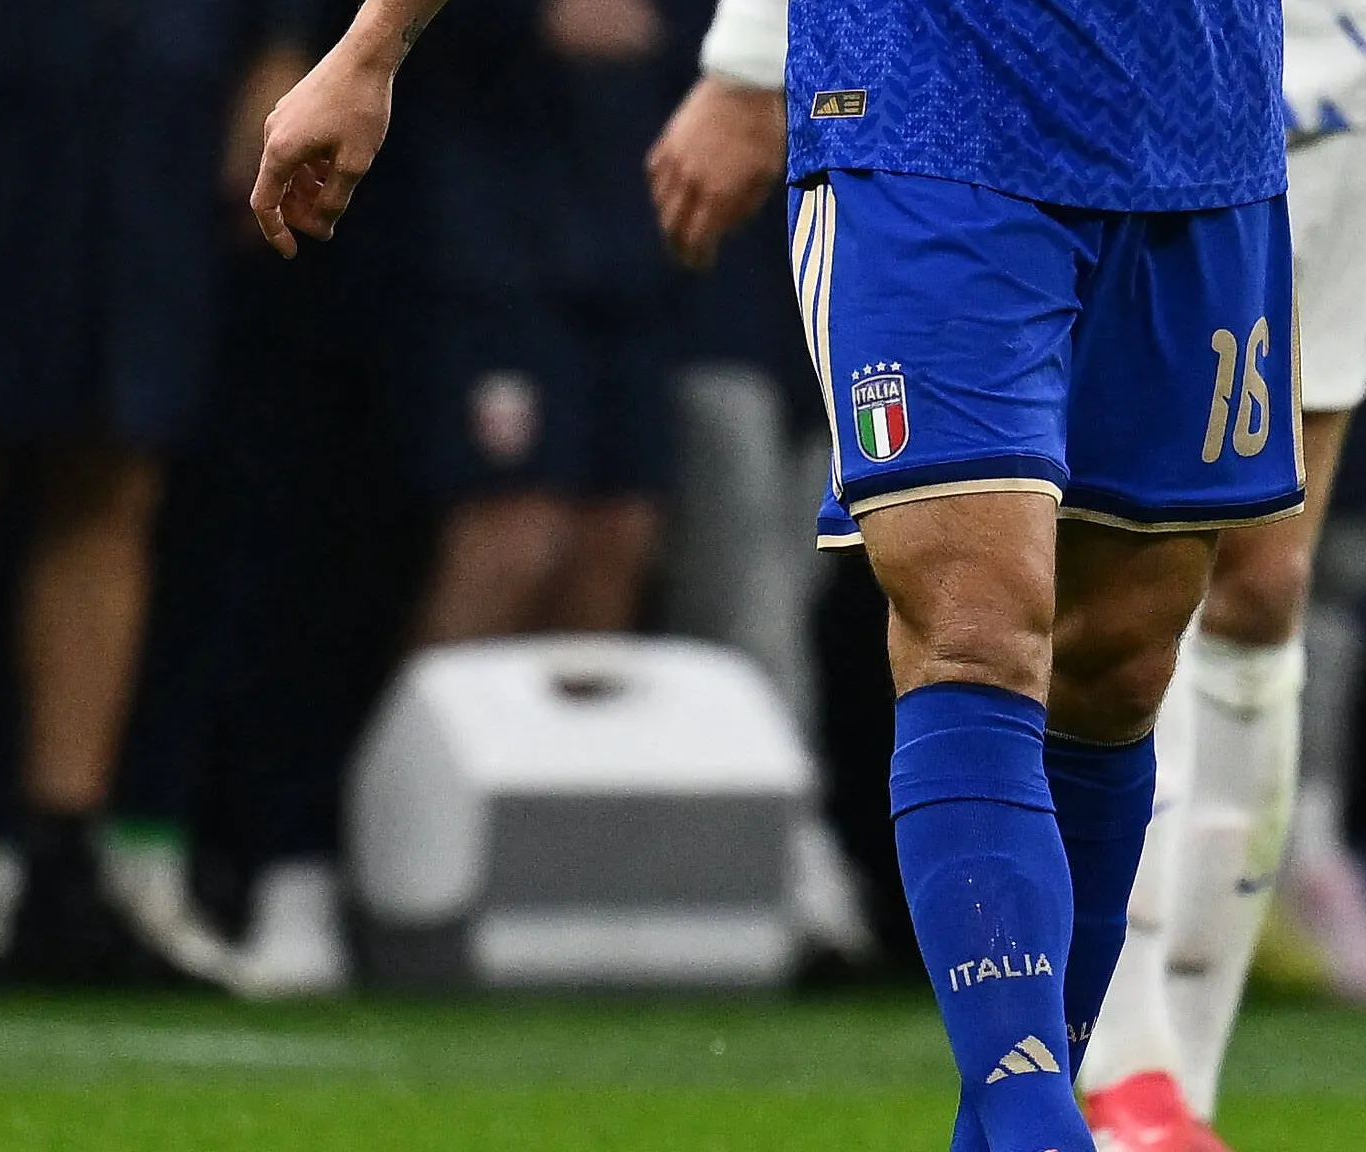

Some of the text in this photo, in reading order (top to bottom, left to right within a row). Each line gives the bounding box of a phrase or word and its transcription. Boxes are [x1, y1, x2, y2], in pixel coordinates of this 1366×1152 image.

[856, 380, 900, 405] ITALIA
[1202, 316, 1270, 463] 16
[948, 952, 1054, 992] ITALIA
